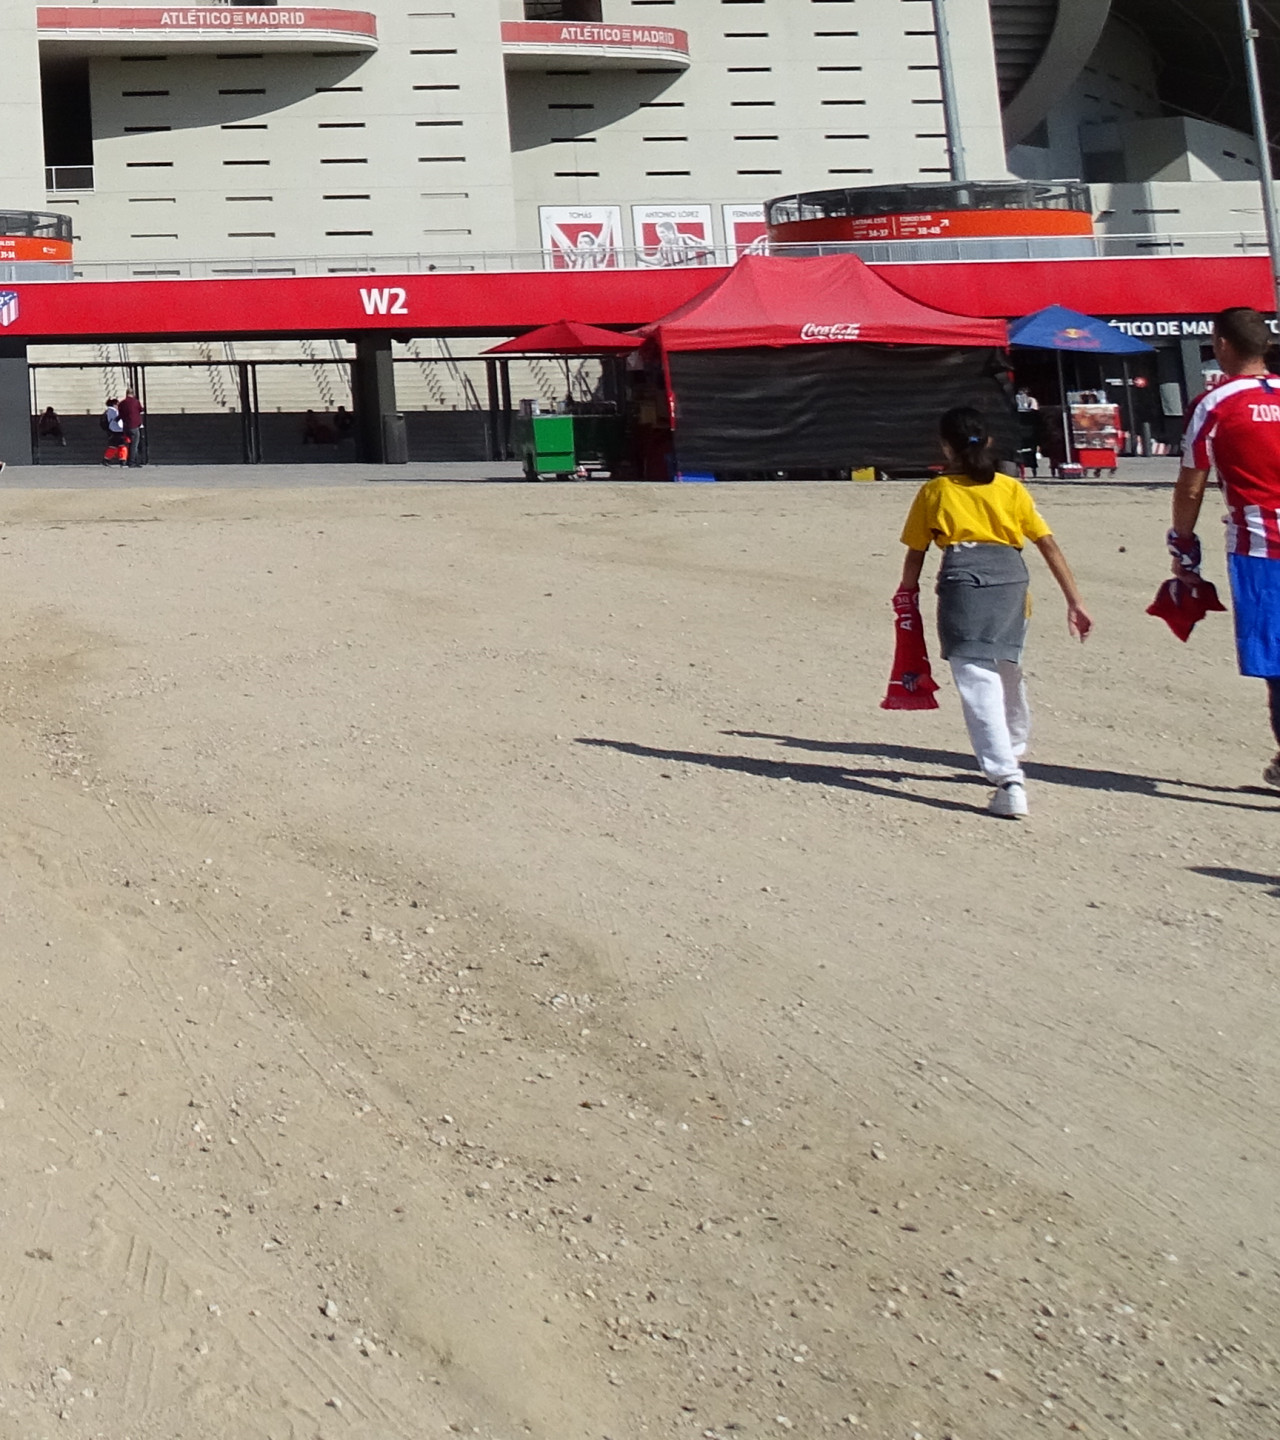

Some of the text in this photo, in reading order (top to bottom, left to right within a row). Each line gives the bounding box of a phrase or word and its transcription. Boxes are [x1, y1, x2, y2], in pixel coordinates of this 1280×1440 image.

[160, 10, 305, 25] ATLÉTICO DE MADRID
[560, 26, 620, 41] ATLÉTICO
[632, 30, 675, 45] MADRID
[569, 211, 592, 219] TOMÁS
[678, 210, 700, 218] LÓPEZ
[359, 287, 408, 315] W2
[800, 323, 860, 341] Coca-Cola
[1156, 322, 1181, 335] DE
